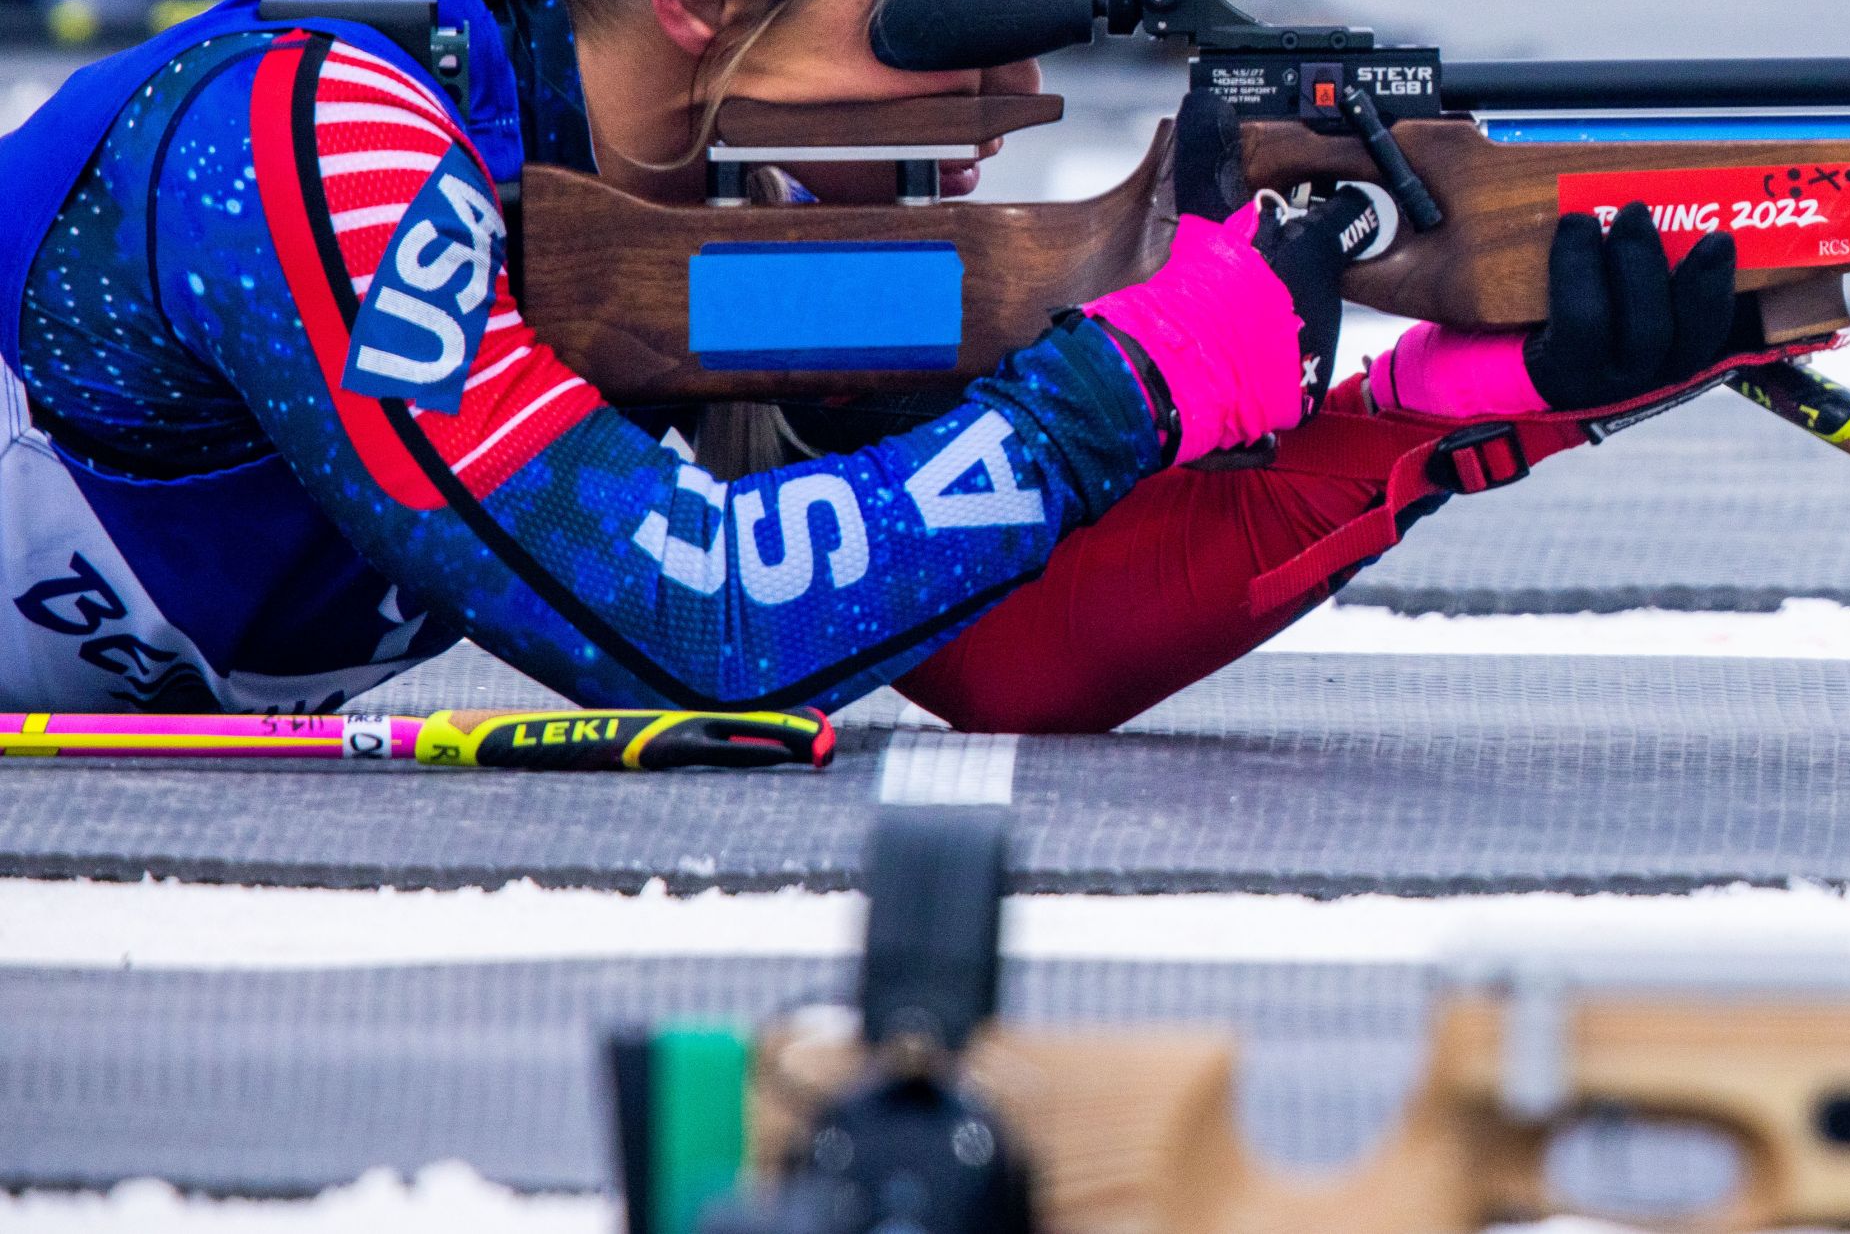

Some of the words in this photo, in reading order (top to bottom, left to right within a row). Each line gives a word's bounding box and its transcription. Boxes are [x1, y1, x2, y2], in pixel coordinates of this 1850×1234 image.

[1357, 66, 1433, 81] STEYR
[1594, 202, 1720, 233] BJING
[1730, 198, 1829, 230] 2022
[1819, 238, 1850, 257] RCS
[356, 171, 507, 387] USA
[633, 410, 1048, 608] USA
[512, 717, 619, 748] LEKI
[431, 744, 460, 761] R
